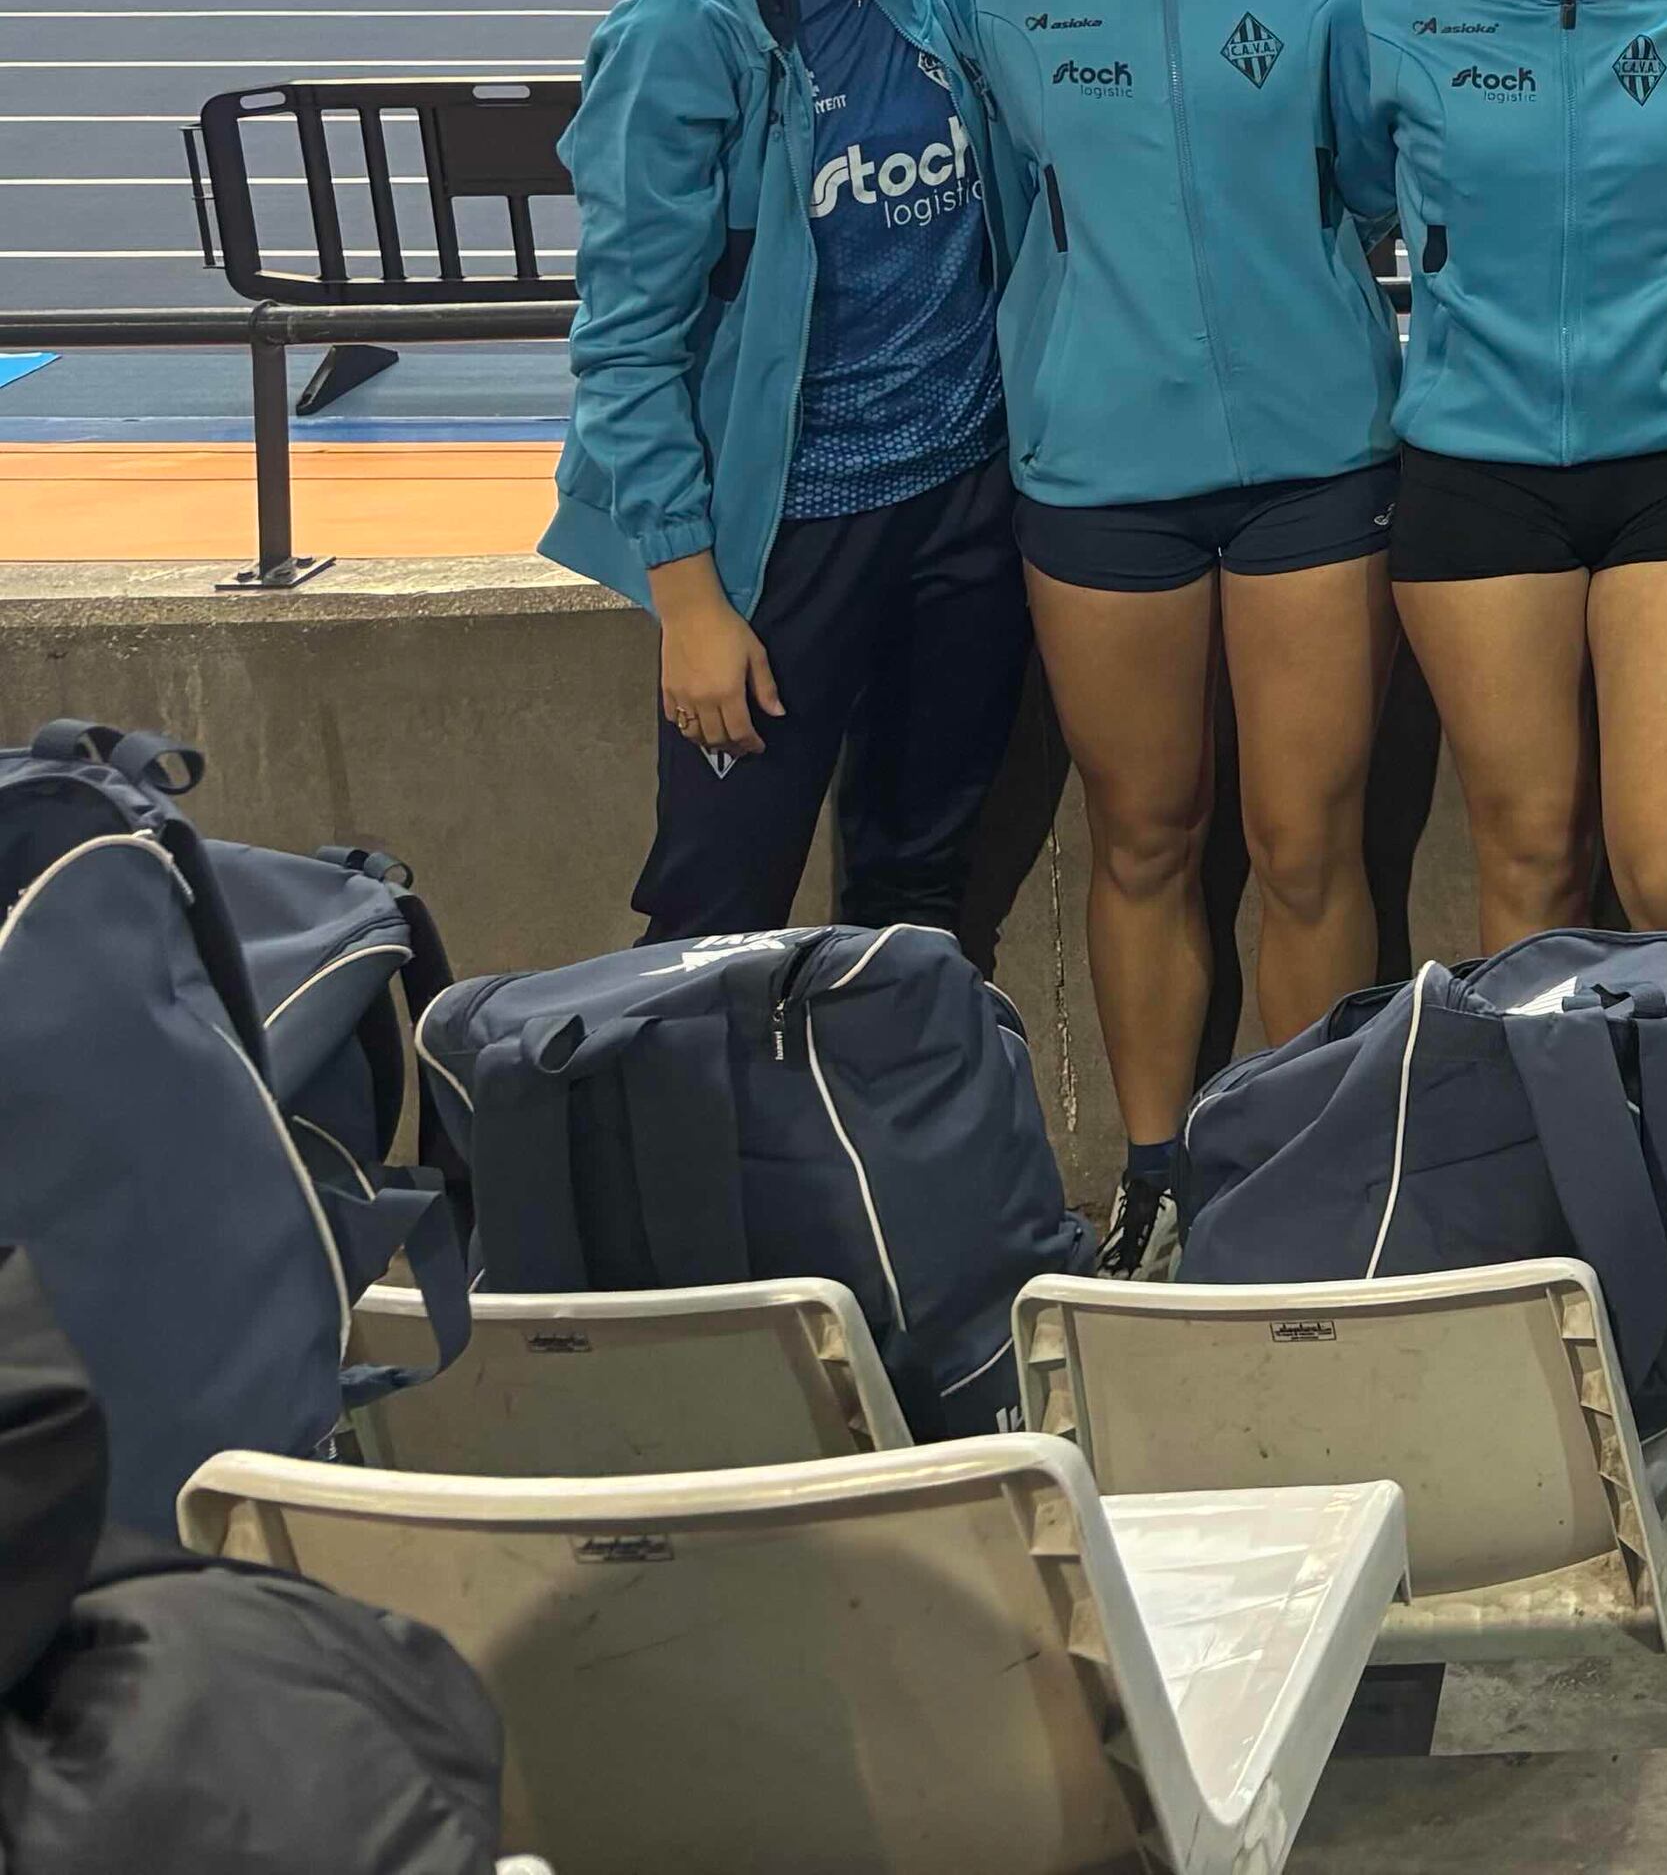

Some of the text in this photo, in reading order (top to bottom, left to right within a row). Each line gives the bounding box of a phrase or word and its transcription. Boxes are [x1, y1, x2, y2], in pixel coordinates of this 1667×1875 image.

[1051, 18, 1103, 30] asioka
[1441, 23, 1497, 34] asioka
[1230, 41, 1275, 57] C.A.V.A.
[1052, 60, 1133, 85] stock
[1451, 65, 1536, 92] stock
[1080, 84, 1133, 100] logistic
[1483, 91, 1537, 103] logistic
